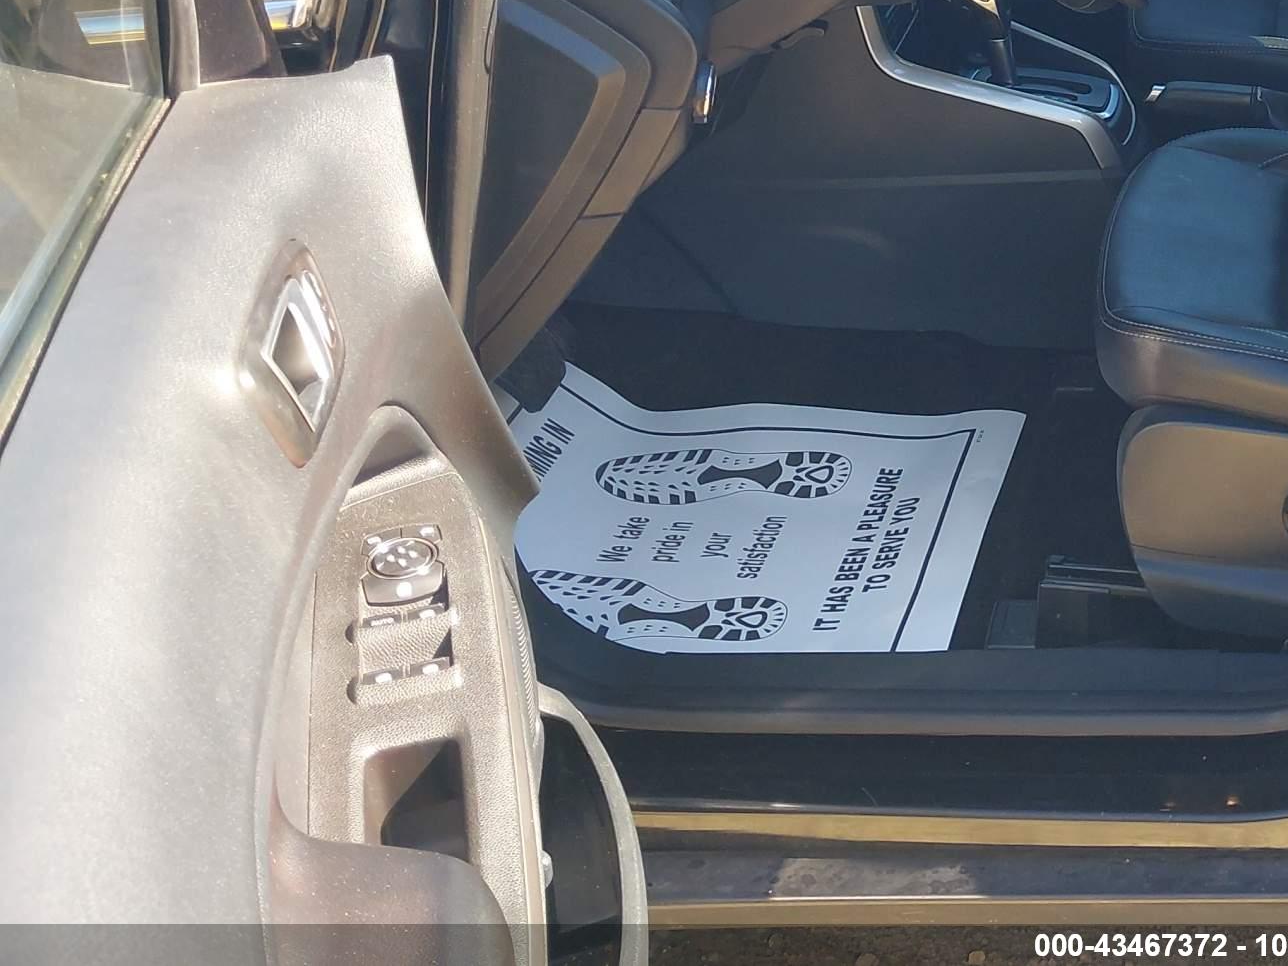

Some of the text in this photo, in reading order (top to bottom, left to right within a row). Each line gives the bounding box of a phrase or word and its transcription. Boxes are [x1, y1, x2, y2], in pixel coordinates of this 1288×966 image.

[523, 418, 575, 482] MING IN
[596, 516, 650, 562] We take
[651, 521, 694, 563] pride in
[701, 532, 732, 558] your
[736, 515, 787, 579] satisfaction
[812, 468, 903, 631] IT HAS BEEN A PLEASURE
[862, 497, 920, 592] TO SERVE YOU
